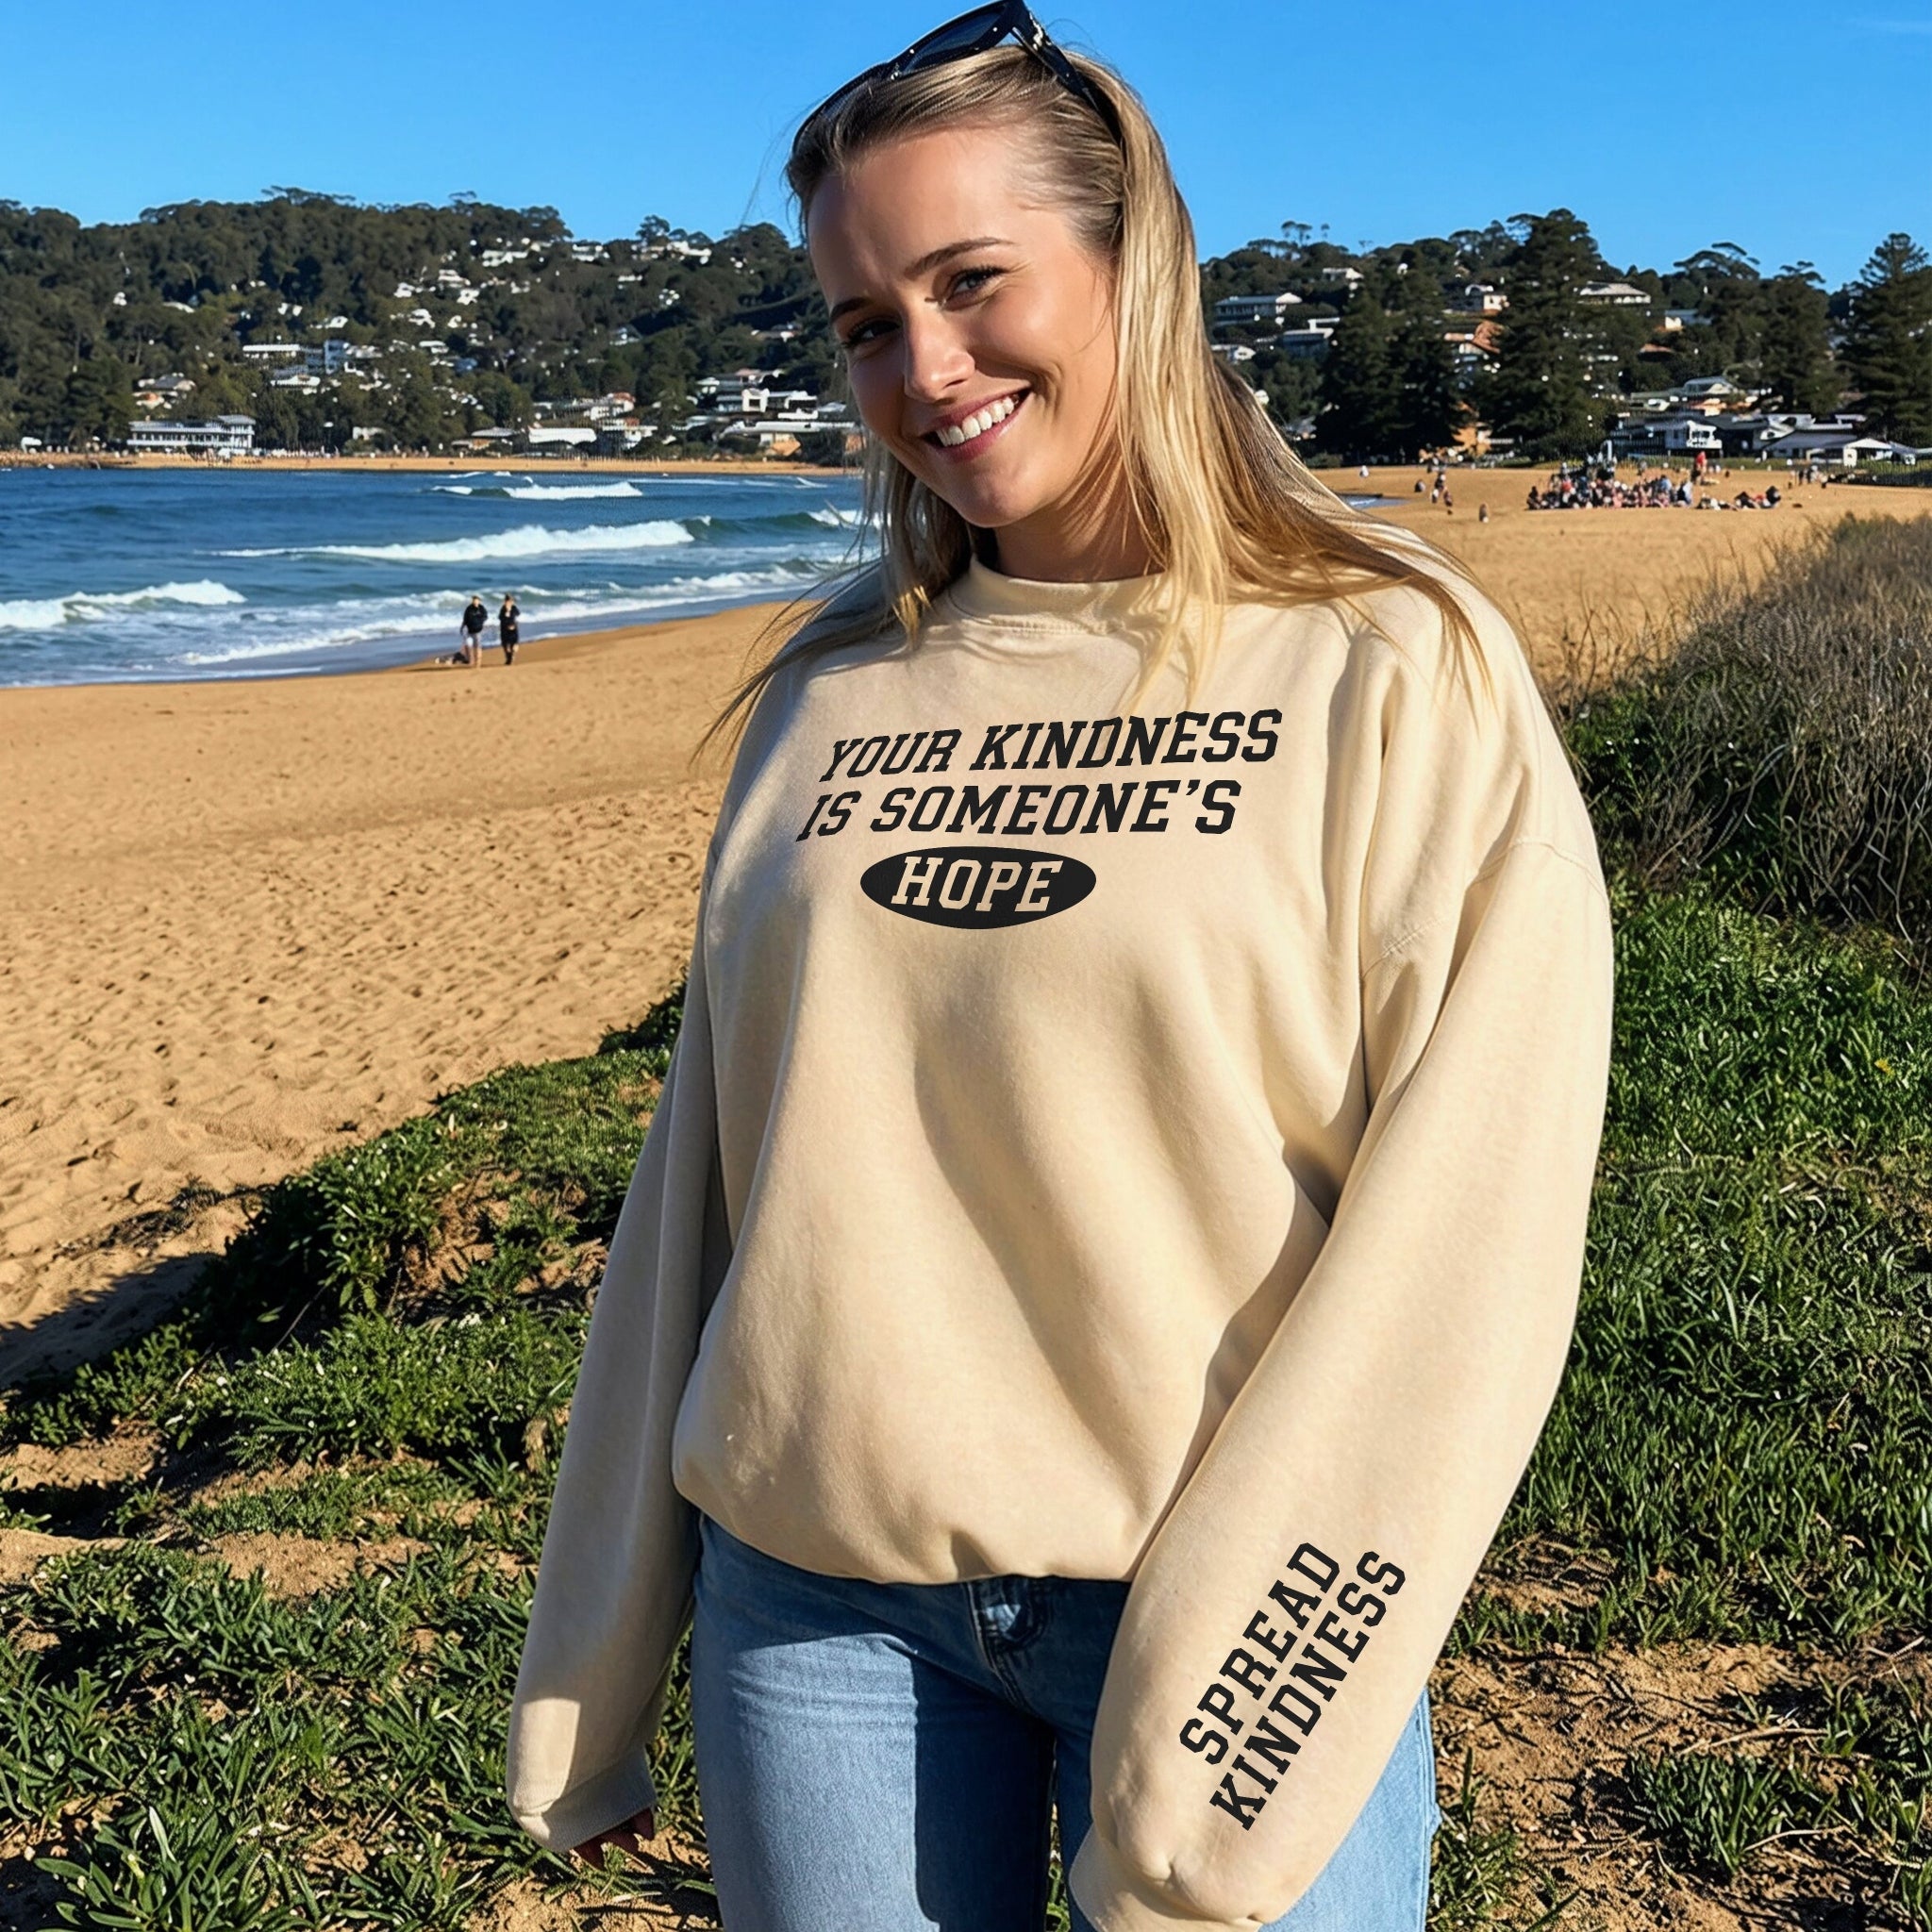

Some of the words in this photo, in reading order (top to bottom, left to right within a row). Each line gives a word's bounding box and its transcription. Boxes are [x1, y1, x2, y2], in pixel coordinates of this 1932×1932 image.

[819, 729, 961, 784] YOUR
[969, 709, 1282, 770] KINDNESS
[796, 791, 861, 841] IS
[891, 856, 1064, 912] HOPE
[1180, 1543, 1340, 1764] SPREAD
[1209, 1552, 1405, 1830] KINDNESS
